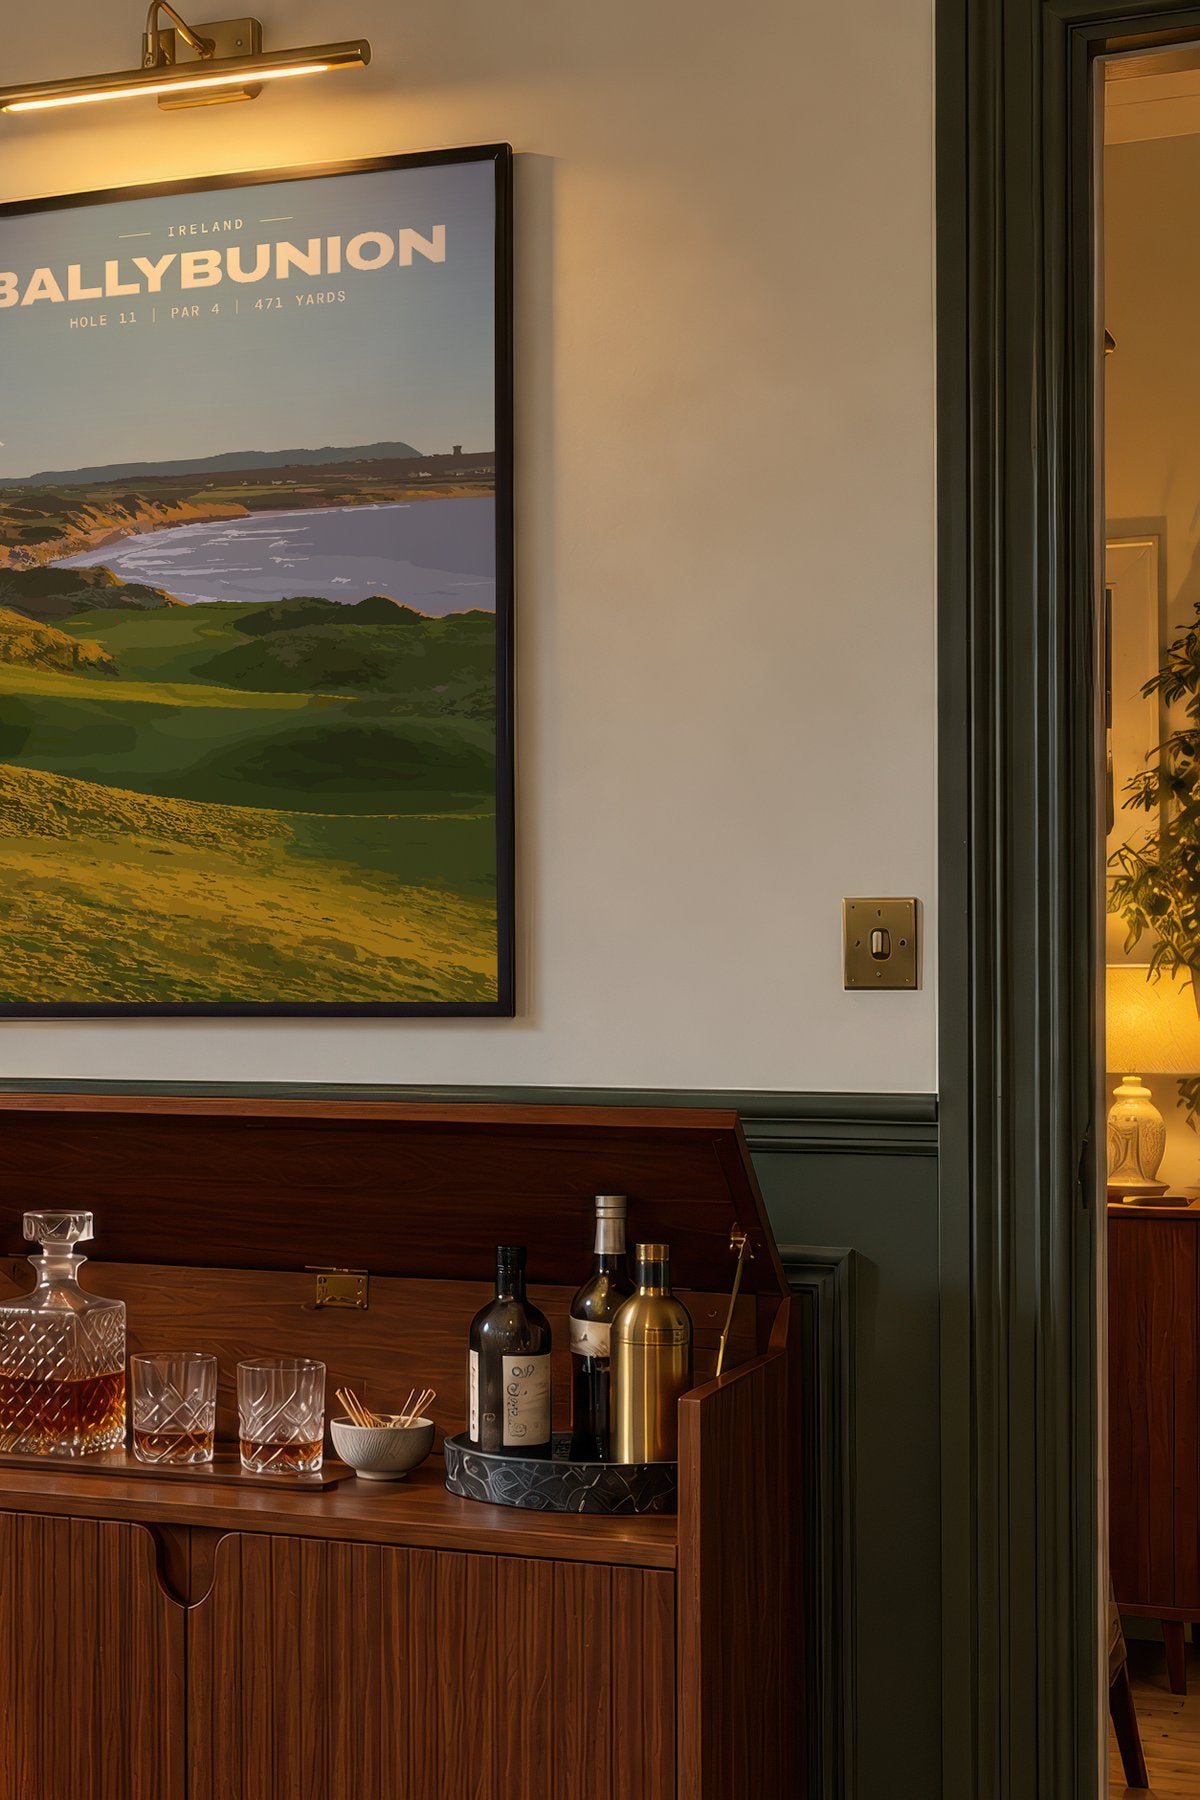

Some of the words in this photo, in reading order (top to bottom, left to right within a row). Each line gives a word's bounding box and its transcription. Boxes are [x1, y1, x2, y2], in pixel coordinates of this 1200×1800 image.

[168, 219, 243, 237] IRELAND
[70, 315, 107, 328] HOLE
[119, 312, 137, 324] 11
[171, 305, 200, 319] PAR
[211, 303, 221, 315] 4
[255, 297, 283, 309] 471
[296, 291, 345, 305] YARDS
